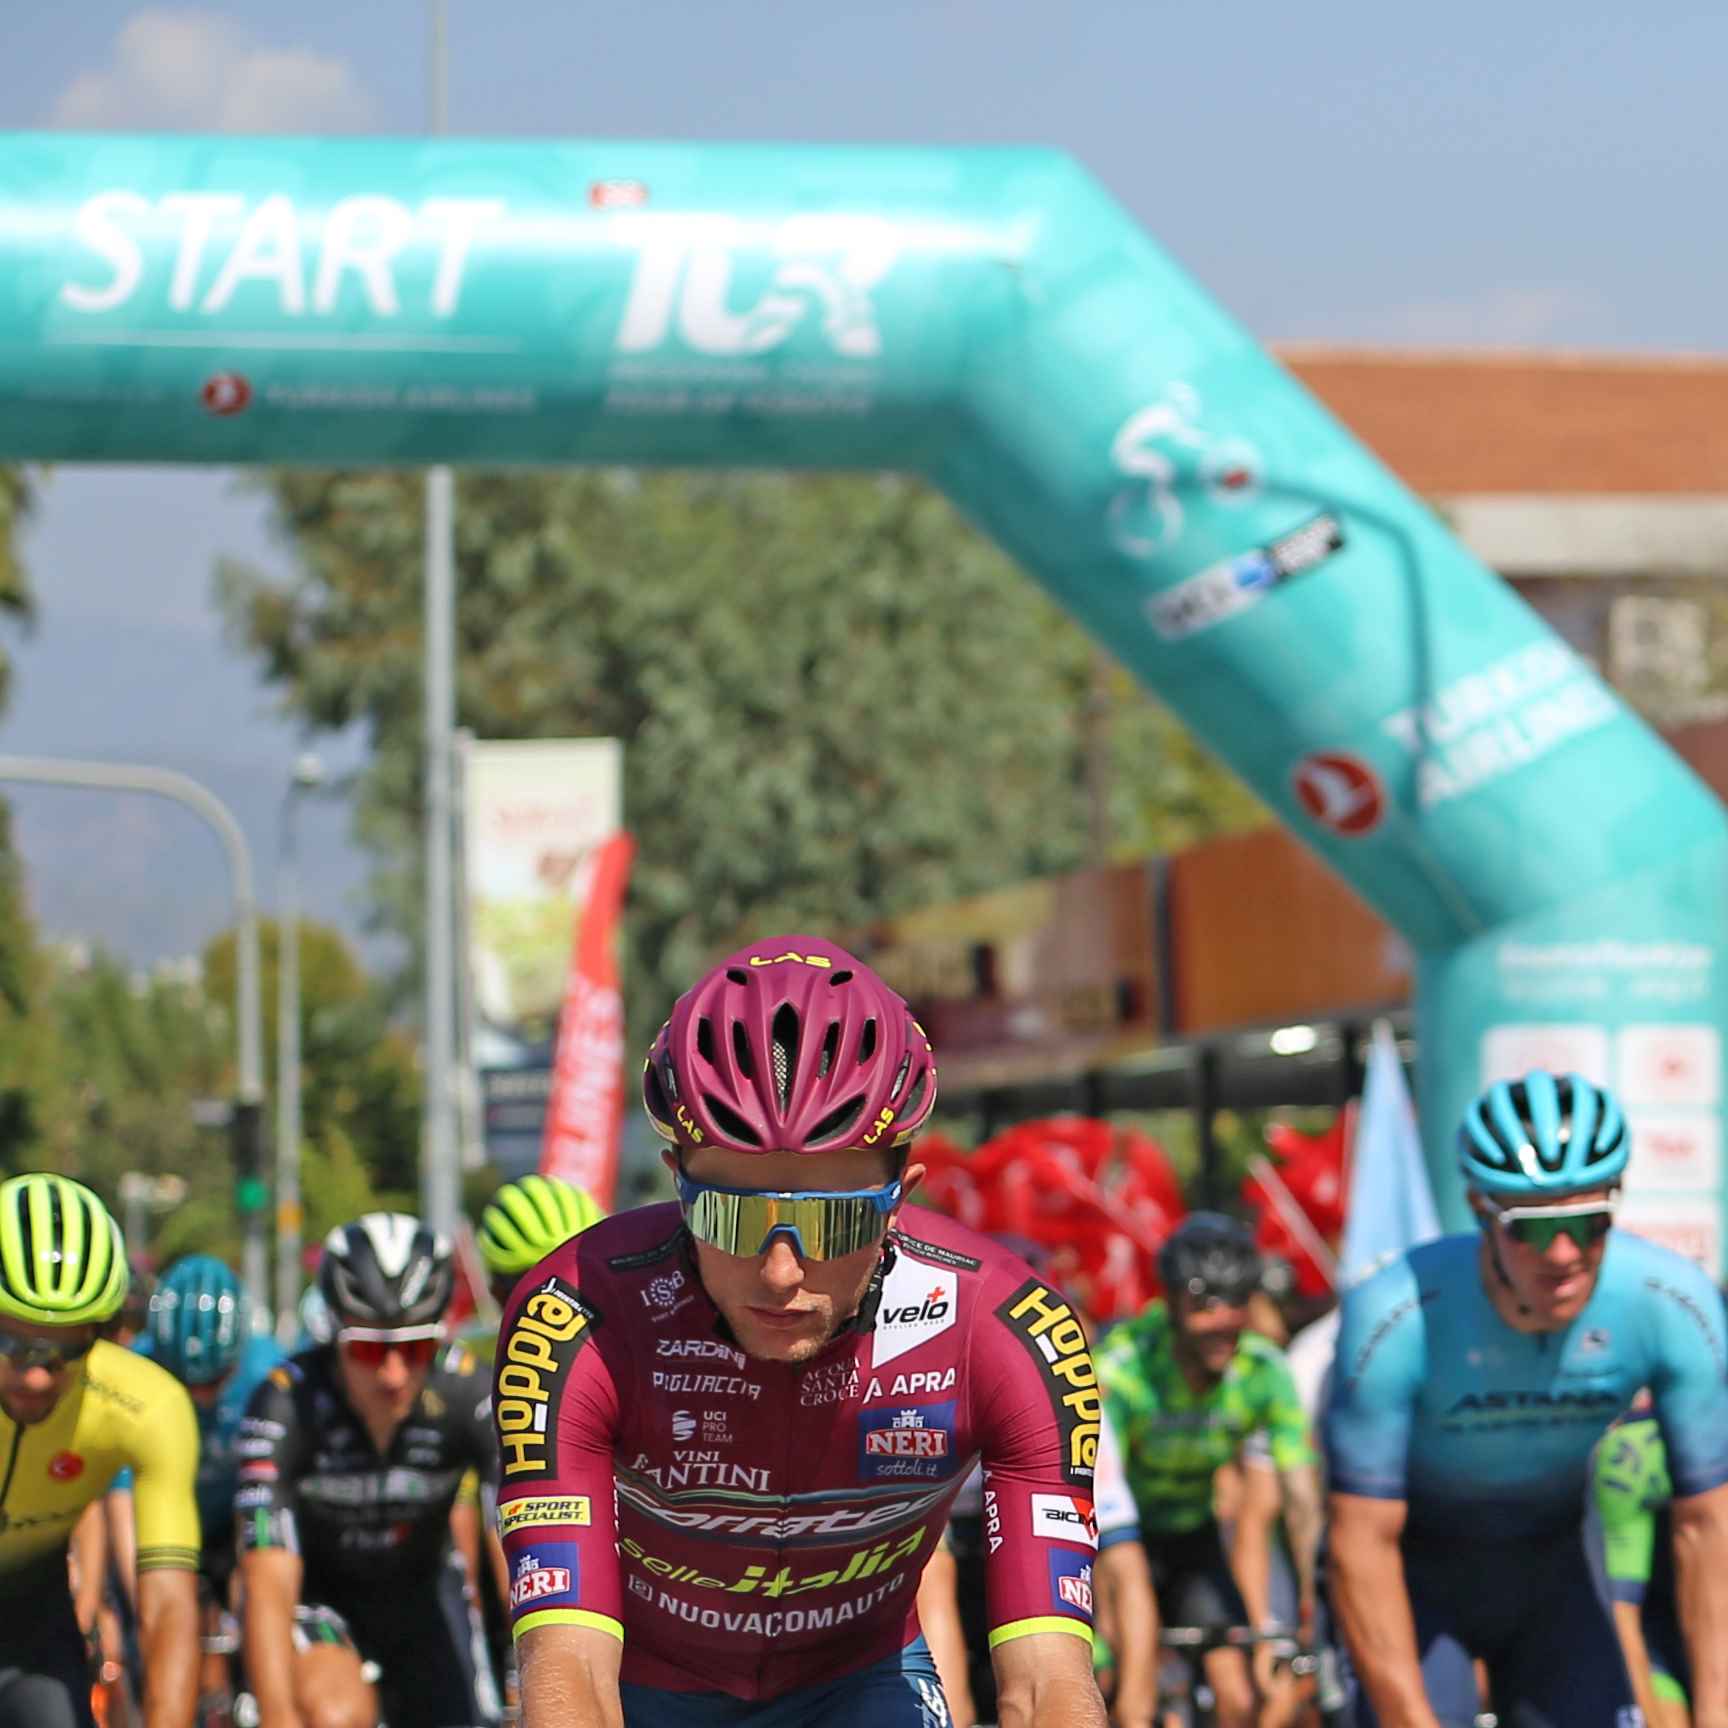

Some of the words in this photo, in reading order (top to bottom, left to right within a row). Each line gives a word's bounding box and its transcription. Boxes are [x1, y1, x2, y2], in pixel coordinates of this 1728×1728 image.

[60, 190, 507, 318] START
[675, 1104, 705, 1145] LAS
[863, 1107, 895, 1145] LAS
[883, 1299, 949, 1324] velo
[890, 1368, 956, 1397] APRA
[702, 1422, 726, 1432] PRO
[703, 1410, 727, 1421] UCI
[702, 1432, 734, 1443] TEAM
[867, 1431, 946, 1455] NERI
[673, 1451, 720, 1463] VINI
[875, 1457, 938, 1477] sottoli.it
[631, 1453, 772, 1492] FANTINI
[524, 1500, 583, 1513] SPORT
[984, 1490, 1004, 1554] APRA
[511, 1568, 568, 1607] NERI
[658, 1571, 906, 1638] NUOVACOMAUTO
